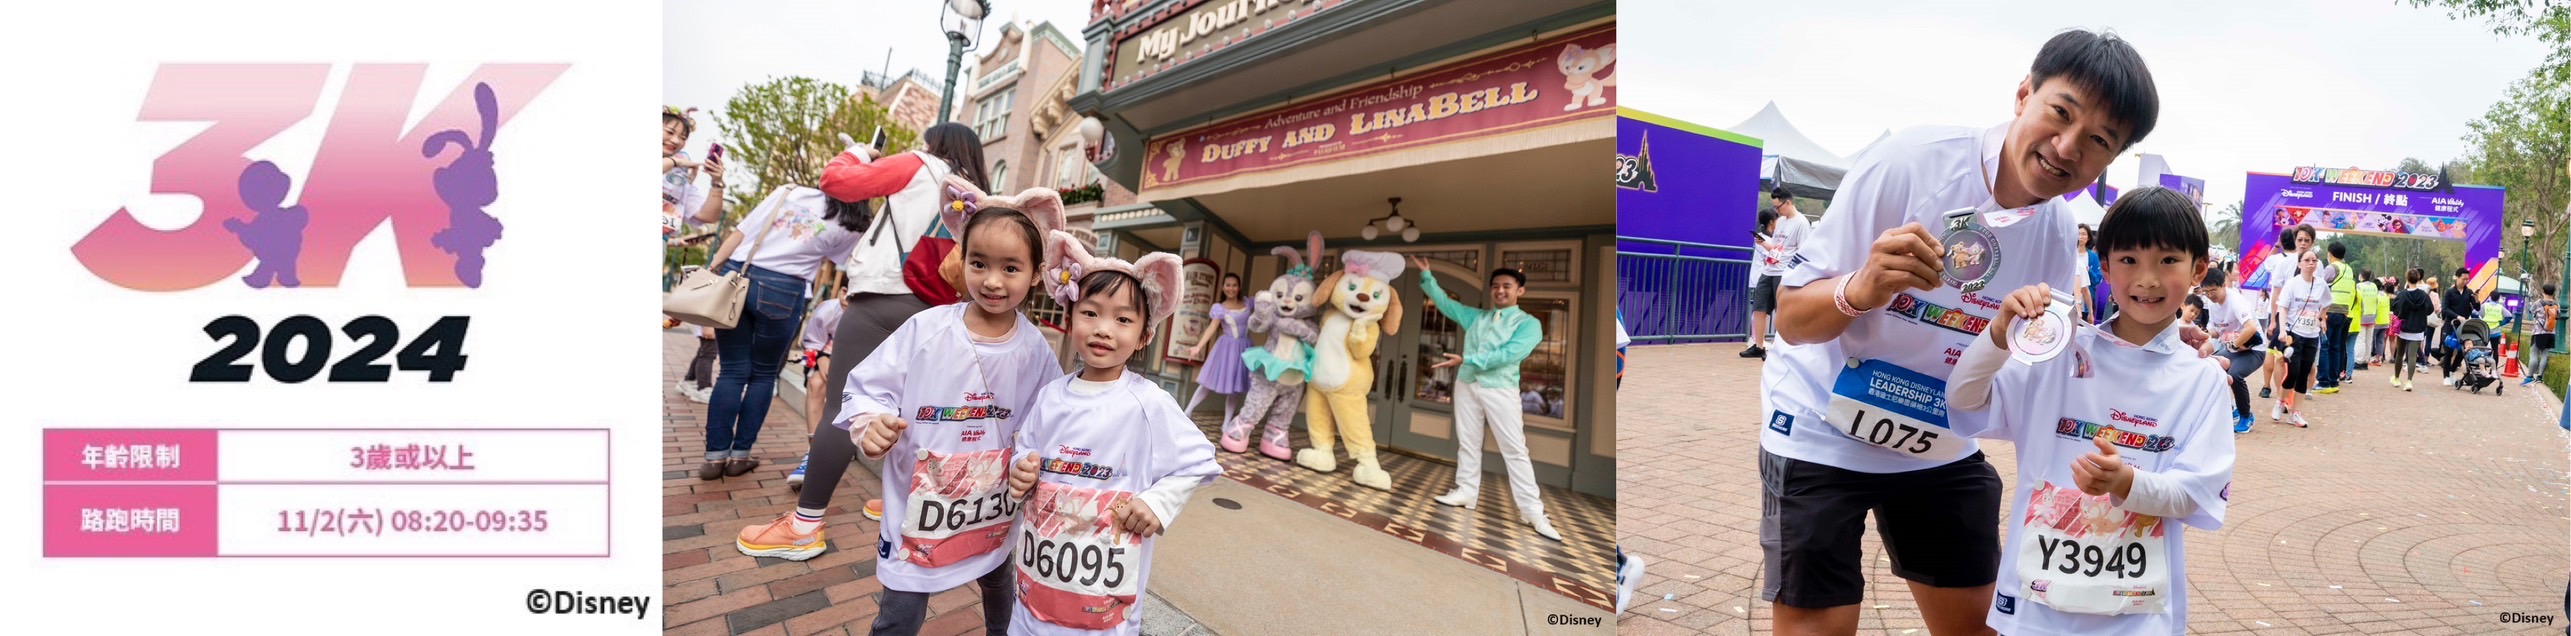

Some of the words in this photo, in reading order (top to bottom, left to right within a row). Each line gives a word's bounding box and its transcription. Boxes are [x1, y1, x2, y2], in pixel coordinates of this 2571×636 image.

[1136, 27, 1179, 63] My
[1179, 0, 1310, 46] Journ
[1264, 110, 1321, 129] Adventure
[1323, 100, 1346, 116] and
[1350, 84, 1423, 110] Friendship
[1201, 135, 1273, 163] DUFFY
[1282, 123, 1336, 148] AND
[2292, 166, 2325, 184] 10K
[2324, 166, 2396, 188] WEEKEND
[2394, 171, 2440, 191] 2023
[2332, 191, 2372, 204] FINISH
[2383, 193, 2409, 207] 終點
[2431, 197, 2447, 205] AIA
[1961, 279, 1986, 293] 2023
[1886, 293, 1928, 318] 10K
[1869, 377, 1933, 404] LEADERSHIP
[1934, 397, 1947, 410] 3K
[1872, 370, 1891, 381] HONG
[1891, 375, 1910, 387] KONG
[1910, 381, 1946, 399] DISNEYLAN
[916, 405, 941, 421] 10K
[1848, 409, 1939, 454] L075
[2056, 417, 2084, 437] 10K
[1078, 462, 1114, 481] 2023
[1023, 531, 1125, 589] D6095
[2038, 534, 2147, 579] Y3949
